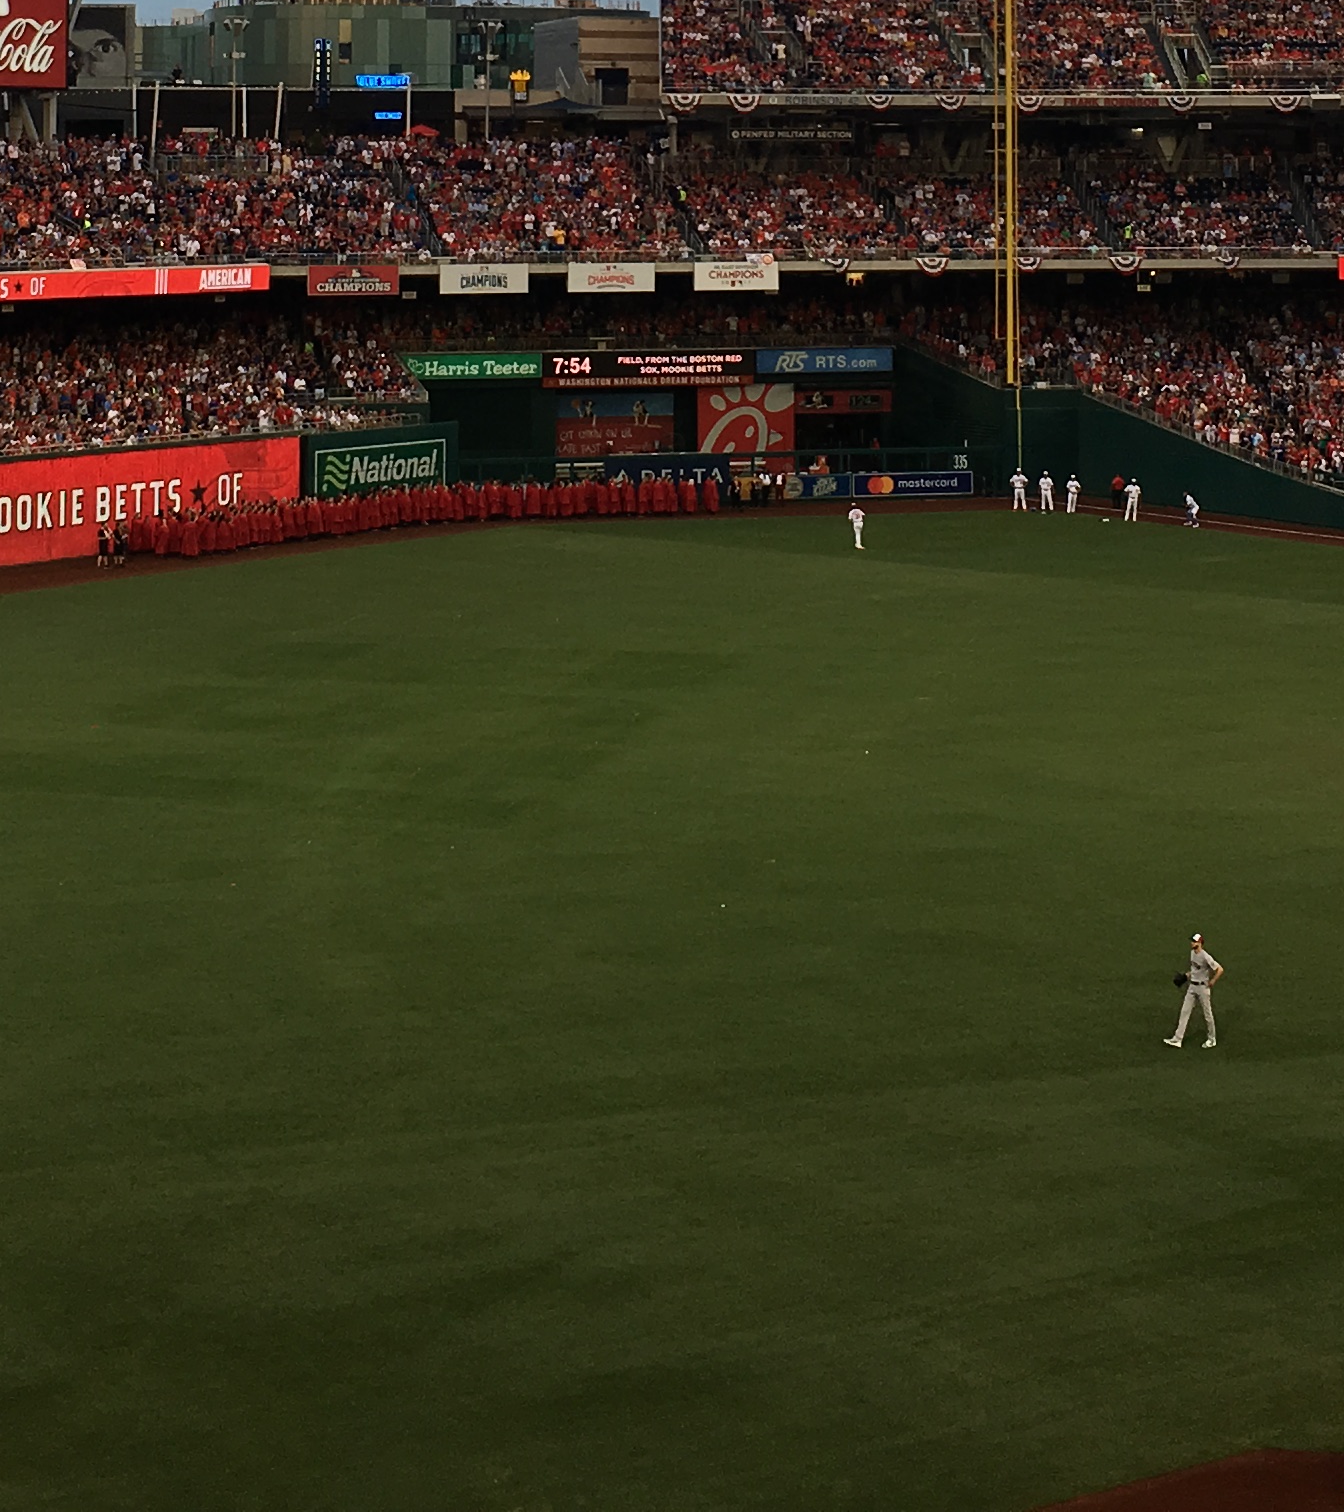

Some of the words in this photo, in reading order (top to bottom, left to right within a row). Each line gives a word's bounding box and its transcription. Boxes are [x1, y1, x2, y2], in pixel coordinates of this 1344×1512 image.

[817, 130, 851, 138] SECTION
[588, 275, 634, 287] CHAMPIONS
[708, 270, 764, 279] CHAMPIONS
[30, 277, 46, 296] OF
[199, 268, 252, 291] AMERICAN
[316, 283, 391, 292] CHAMPIONS
[461, 274, 508, 289] CHAMPIONS
[553, 357, 591, 375] 7:54
[618, 356, 644, 365] FIELD,
[645, 356, 670, 364] FROM
[690, 355, 723, 363] BOSTON
[725, 355, 743, 363] RED
[775, 351, 809, 372] RTS
[816, 355, 877, 369] RTS.com
[424, 361, 479, 377] Harris
[483, 360, 537, 375] Teeter
[696, 365, 722, 373] BETTS
[559, 378, 611, 386] WASHINGTON
[613, 377, 657, 386] NATIONALS
[660, 377, 687, 385] DREAM
[690, 376, 740, 384] FOUNDATION
[350, 449, 436, 485] National
[953, 455, 968, 470] 335
[898, 477, 957, 488] mastercard
[95, 479, 182, 523] BETTS
[217, 473, 243, 506] OF
